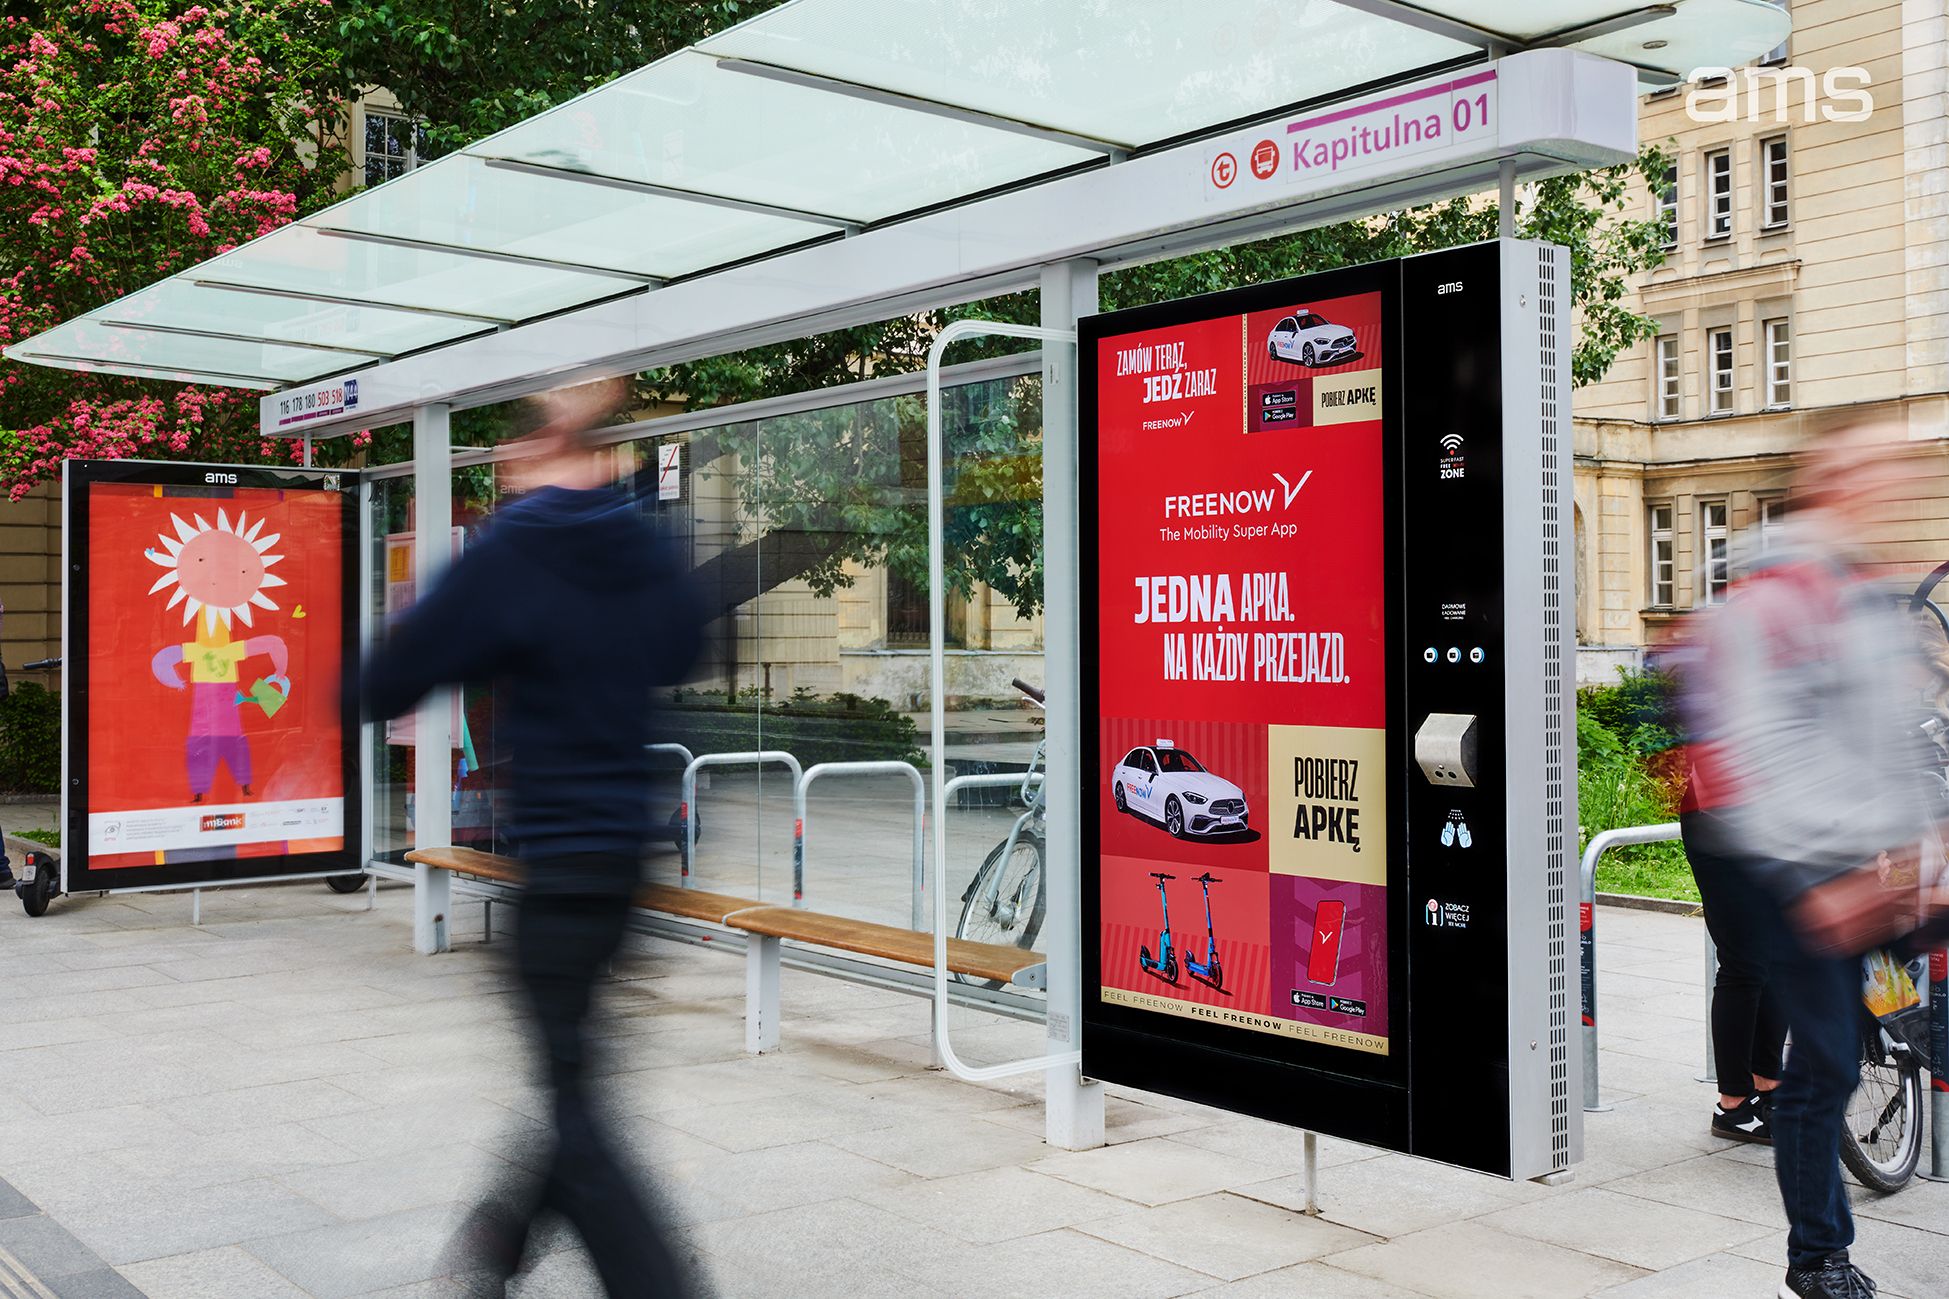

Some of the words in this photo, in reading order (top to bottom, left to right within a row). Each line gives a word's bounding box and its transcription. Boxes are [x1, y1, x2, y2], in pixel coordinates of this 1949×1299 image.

[1293, 114, 1441, 170] Kapitulna
[1453, 93, 1488, 132] 01
[1437, 281, 1464, 295] ams
[1116, 342, 1153, 377] ZAMÓW
[1143, 367, 1183, 404] JEDŹ
[1185, 368, 1217, 398] ZARAZ
[280, 400, 290, 415] 116
[292, 396, 303, 412] 178
[305, 393, 316, 409] 180
[317, 390, 329, 407] 503
[331, 387, 343, 404] 518
[1321, 389, 1346, 408] POBIERZ
[1347, 386, 1377, 406] APKĘ
[1142, 417, 1183, 431] FREENOW
[205, 472, 238, 484] ams
[1440, 468, 1465, 479] ZONE
[1164, 488, 1275, 519] FREENOW
[1159, 527, 1181, 542] The
[1183, 524, 1230, 542] Mobility
[1233, 524, 1269, 540] Super
[1270, 522, 1298, 538] App
[1134, 573, 1235, 624] JEDNA
[1240, 571, 1295, 622] APKA.
[1163, 632, 1188, 681] NA
[1192, 625, 1249, 682] KAŻDY
[1253, 632, 1350, 684] PRZEJAZD.
[1294, 756, 1359, 802] POBIERZ
[203, 816, 243, 829] mBank
[1293, 804, 1361, 853] APKĘ
[1445, 902, 1470, 913] ZOBACZ
[1445, 911, 1470, 922] WIĘCEJ
[1301, 997, 1312, 1005] App
[1311, 997, 1324, 1008] Store
[1339, 1003, 1355, 1013] Google
[1354, 1006, 1365, 1016] Play
[1104, 990, 1128, 1002] FEEL
[1133, 996, 1184, 1012] FREENOW
[1191, 1007, 1219, 1018] FEEL
[1223, 1012, 1282, 1030] FREENOW
[1288, 1024, 1317, 1038] FEEL
[1323, 1031, 1385, 1050] FREENOW
